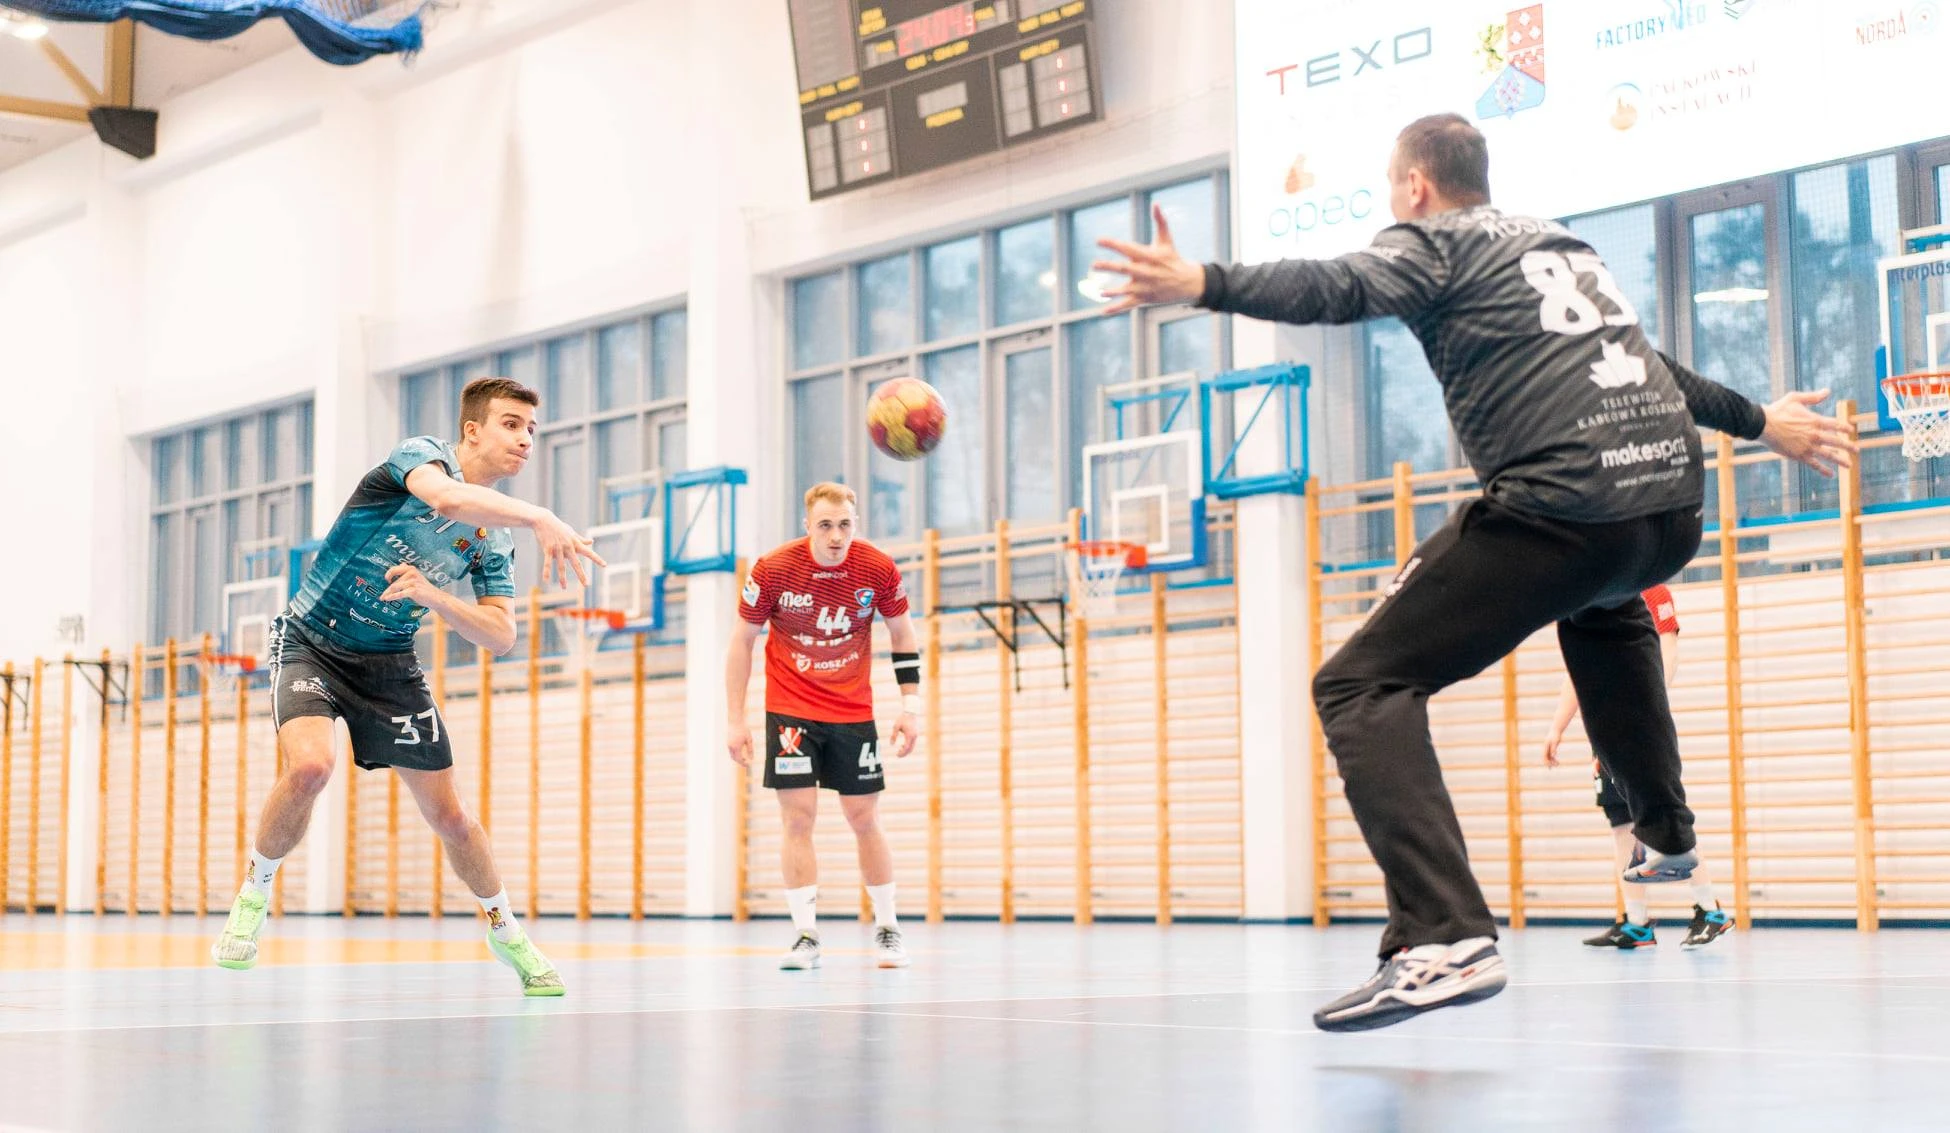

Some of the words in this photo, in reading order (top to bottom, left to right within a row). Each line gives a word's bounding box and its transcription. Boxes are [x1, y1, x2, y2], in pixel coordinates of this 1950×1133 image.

[1856, 9, 1907, 45] NORDA
[1266, 27, 1432, 95] TEXO
[1268, 189, 1372, 244] opec
[355, 575, 403, 610] TEO
[816, 606, 852, 636] 44
[391, 707, 440, 745] 37
